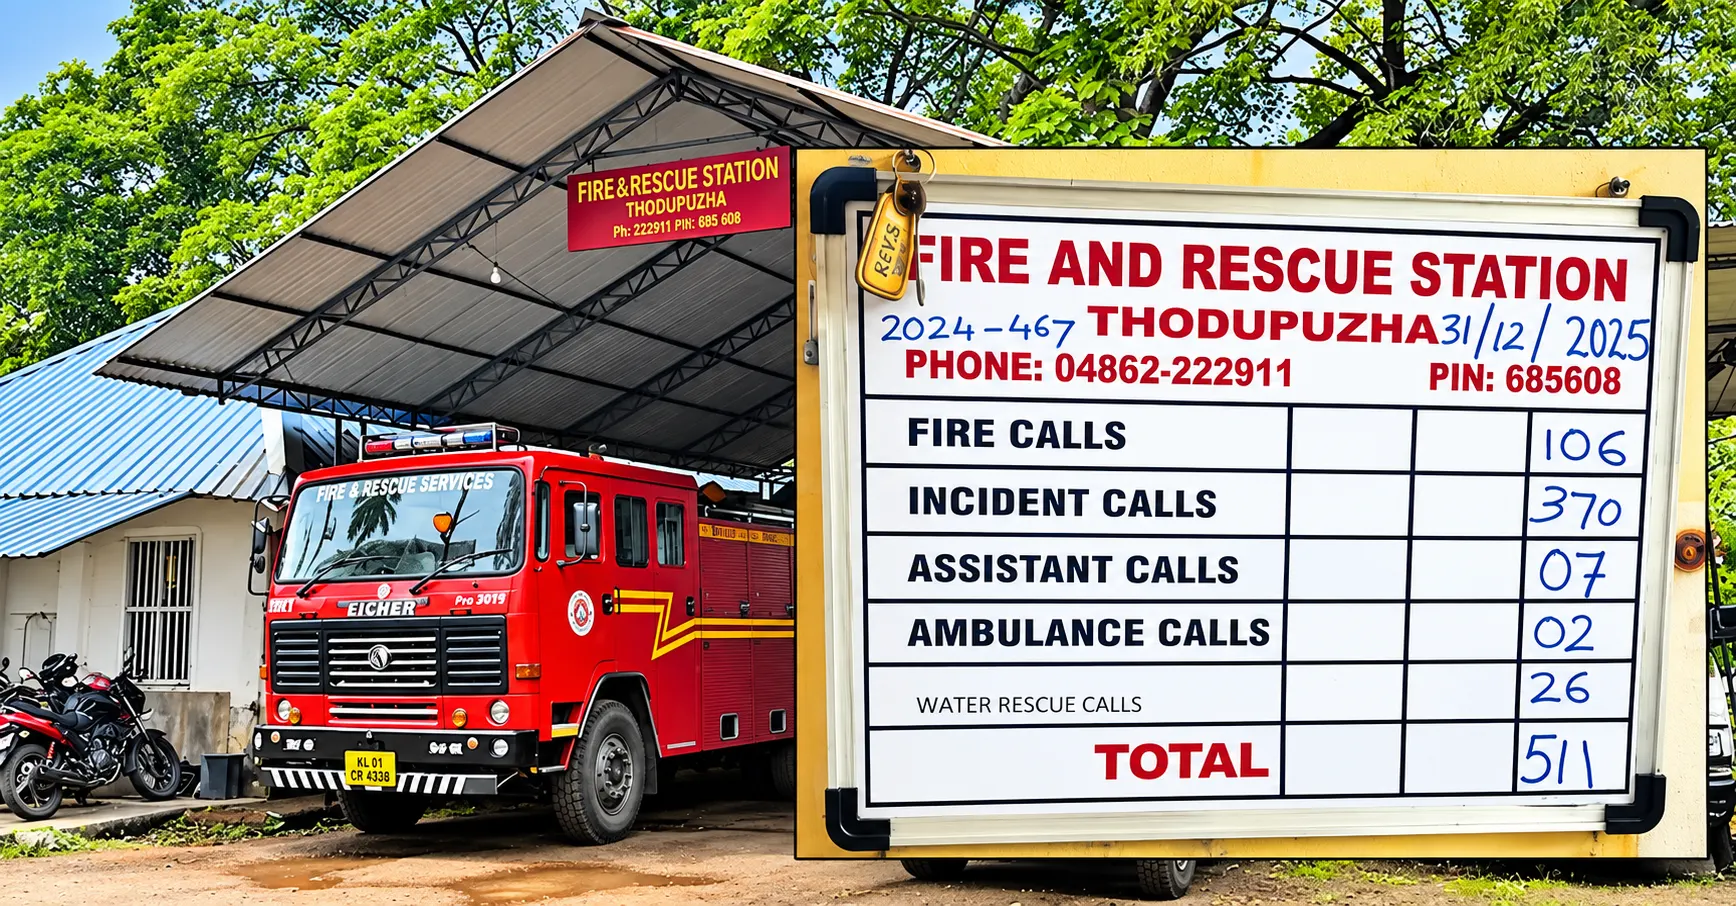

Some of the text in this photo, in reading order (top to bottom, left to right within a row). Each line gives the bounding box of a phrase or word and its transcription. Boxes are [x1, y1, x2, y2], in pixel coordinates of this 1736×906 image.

[702, 156, 779, 188] STATION
[625, 191, 727, 218] THODUPUZHA
[613, 225, 631, 238] Ph:
[633, 220, 671, 237] 222911
[674, 218, 695, 232] PIN:
[721, 211, 742, 225] 608
[1048, 240, 1162, 288] AND
[1182, 243, 1393, 295] RESCUE
[1410, 252, 1628, 302] STATION
[1087, 305, 1440, 345] THODUPUZHA
[905, 349, 1292, 387] PHONE: 04862-222911
[1429, 362, 1621, 395] PIN: 685608
[908, 417, 1126, 450] FIRE CALLS
[1545, 428, 1627, 467] 106
[316, 471, 495, 502] FIRE & RESCUE SERVICES
[909, 486, 1217, 518] INCIDENT CALLS
[1528, 485, 1622, 530] 370
[907, 553, 1239, 584] ASSISTANT CALLS
[1539, 549, 1607, 598] 07
[347, 600, 417, 617] EICHER
[454, 594, 474, 606] Pro
[907, 618, 1270, 647] AMBULANCE CALLS
[1533, 614, 1595, 652] 02
[1530, 671, 1590, 704] 26
[916, 696, 1142, 714] WATER RESCUE CALLS
[350, 770, 390, 782] CR 4338
[357, 757, 383, 768] KL 01
[1094, 742, 1270, 781] TOTAL
[1520, 733, 1594, 789] 511
